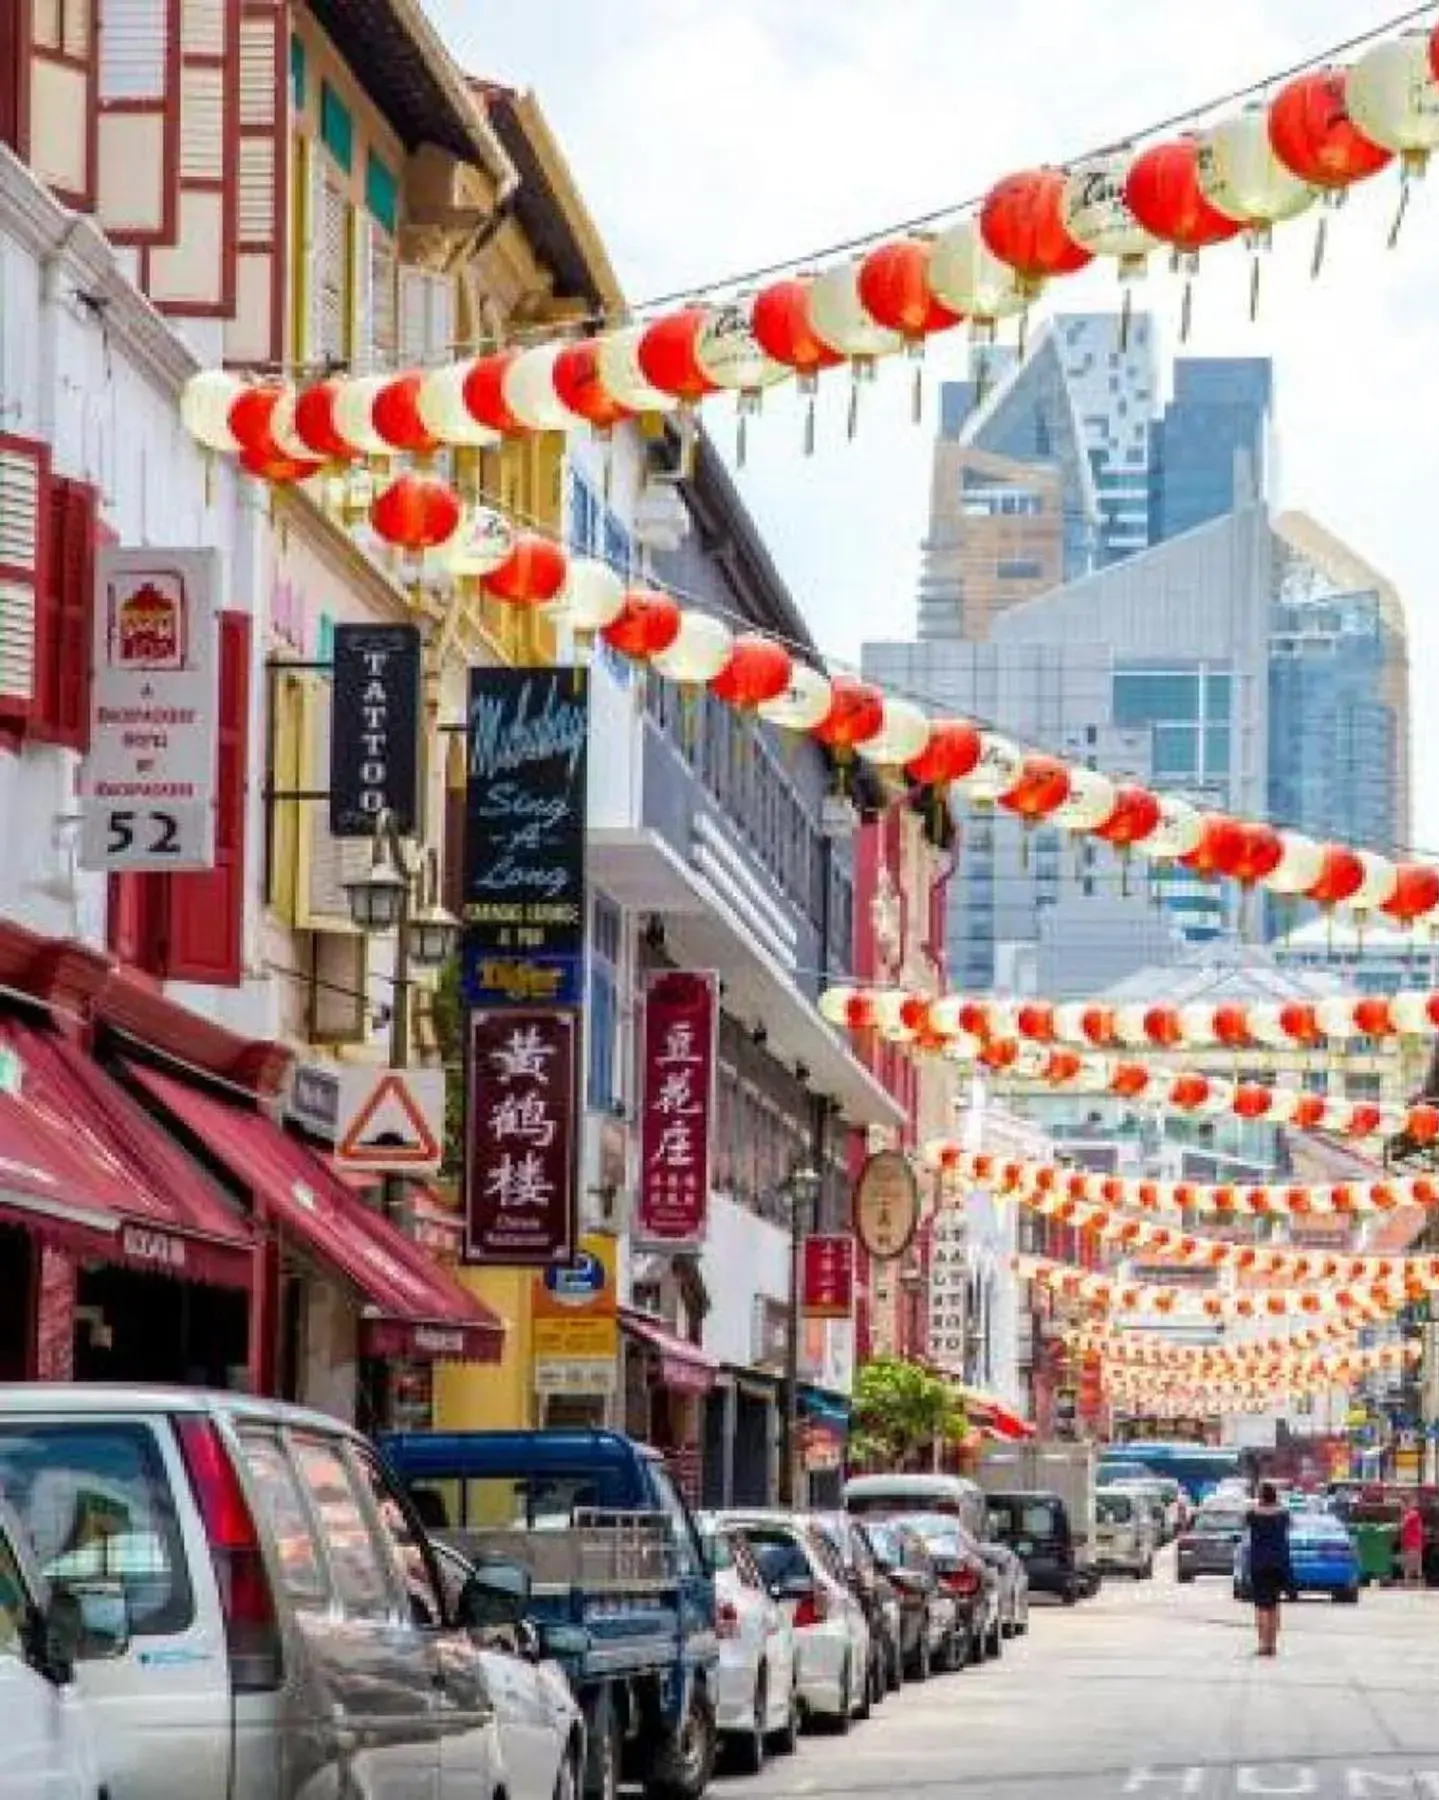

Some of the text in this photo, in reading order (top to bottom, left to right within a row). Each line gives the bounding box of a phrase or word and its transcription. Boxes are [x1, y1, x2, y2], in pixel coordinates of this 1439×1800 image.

[359, 652, 387, 812] TATTOO
[480, 782, 571, 828] Sing
[107, 811, 181, 853] 52
[474, 854, 569, 897] Long
